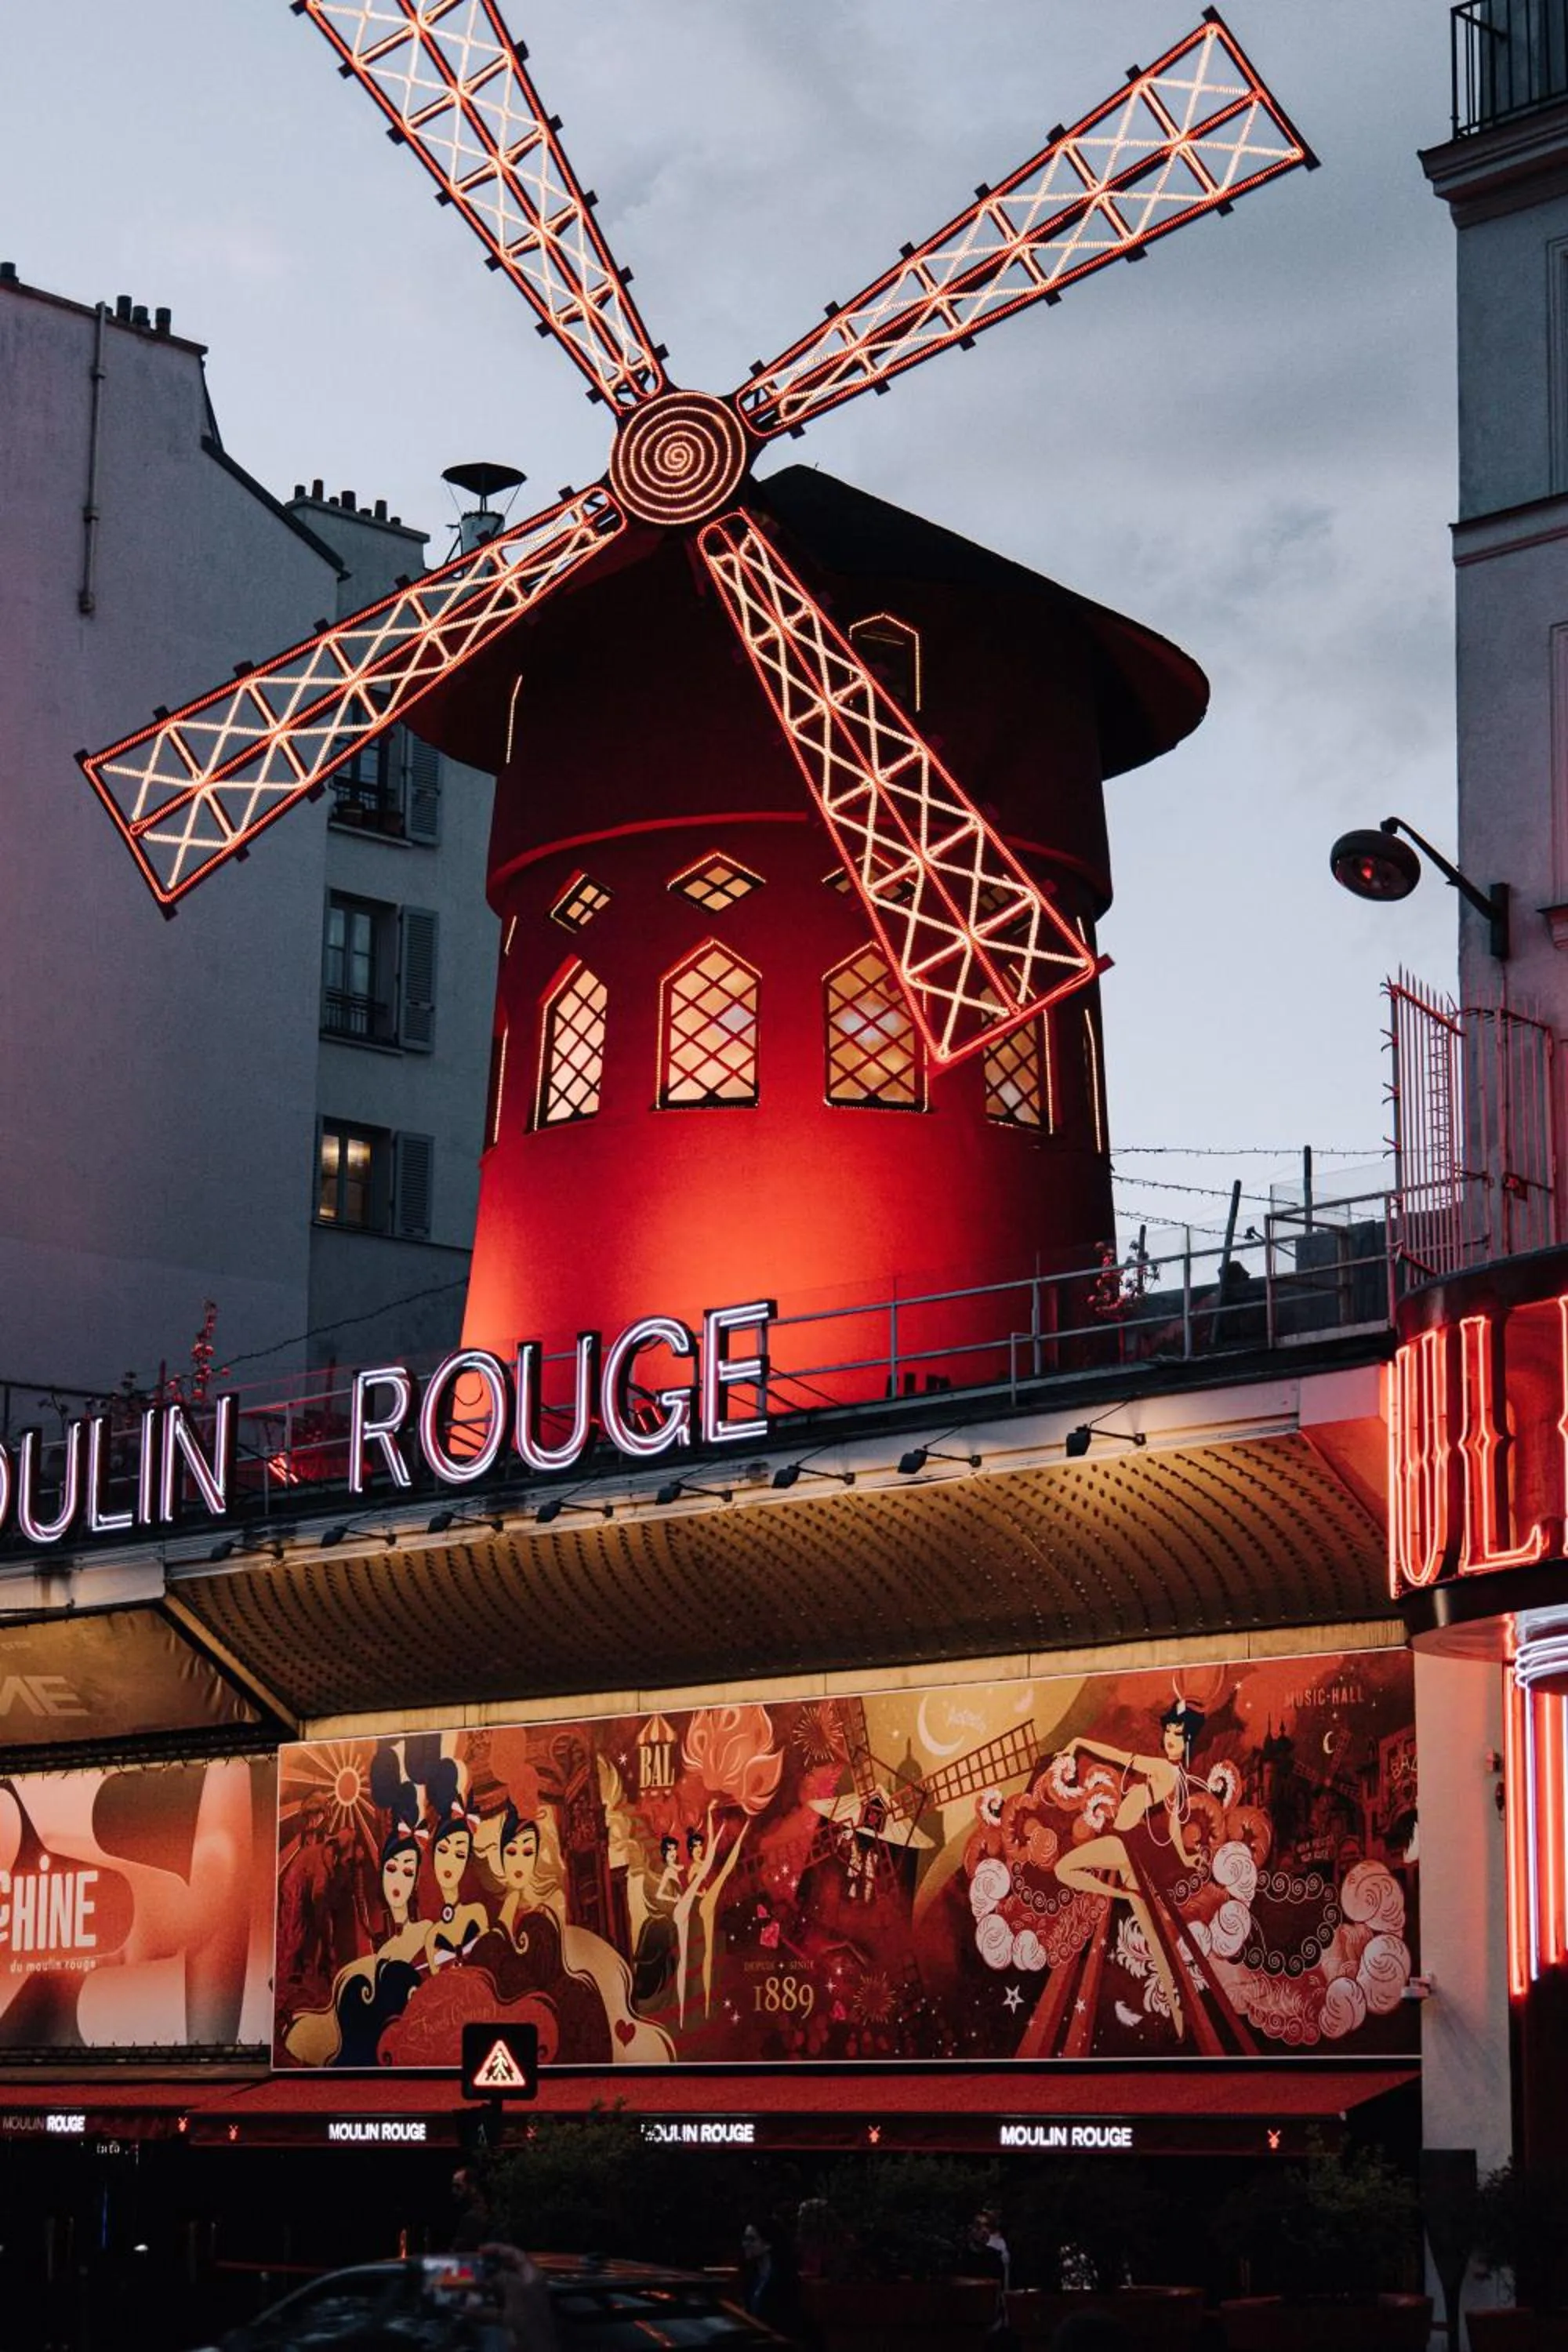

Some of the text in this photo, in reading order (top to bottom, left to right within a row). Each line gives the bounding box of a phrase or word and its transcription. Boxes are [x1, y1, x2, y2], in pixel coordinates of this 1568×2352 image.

[0, 1298, 776, 1543] ULIN ROUGE
[1396, 1295, 1568, 1587] UL
[1284, 1686, 1364, 1708] MUSIC-HALL
[639, 1743, 677, 1790] BAL
[10, 1961, 23, 1973] du
[65, 1958, 96, 1973] rouge
[753, 1976, 814, 2020] 1889
[2, 2114, 85, 2132] MOULIN ROUGE
[328, 2122, 426, 2141] MOULIN ROUGE
[701, 2123, 755, 2142] ROUGE
[1000, 2125, 1133, 2147] MOULIN ROUGE
